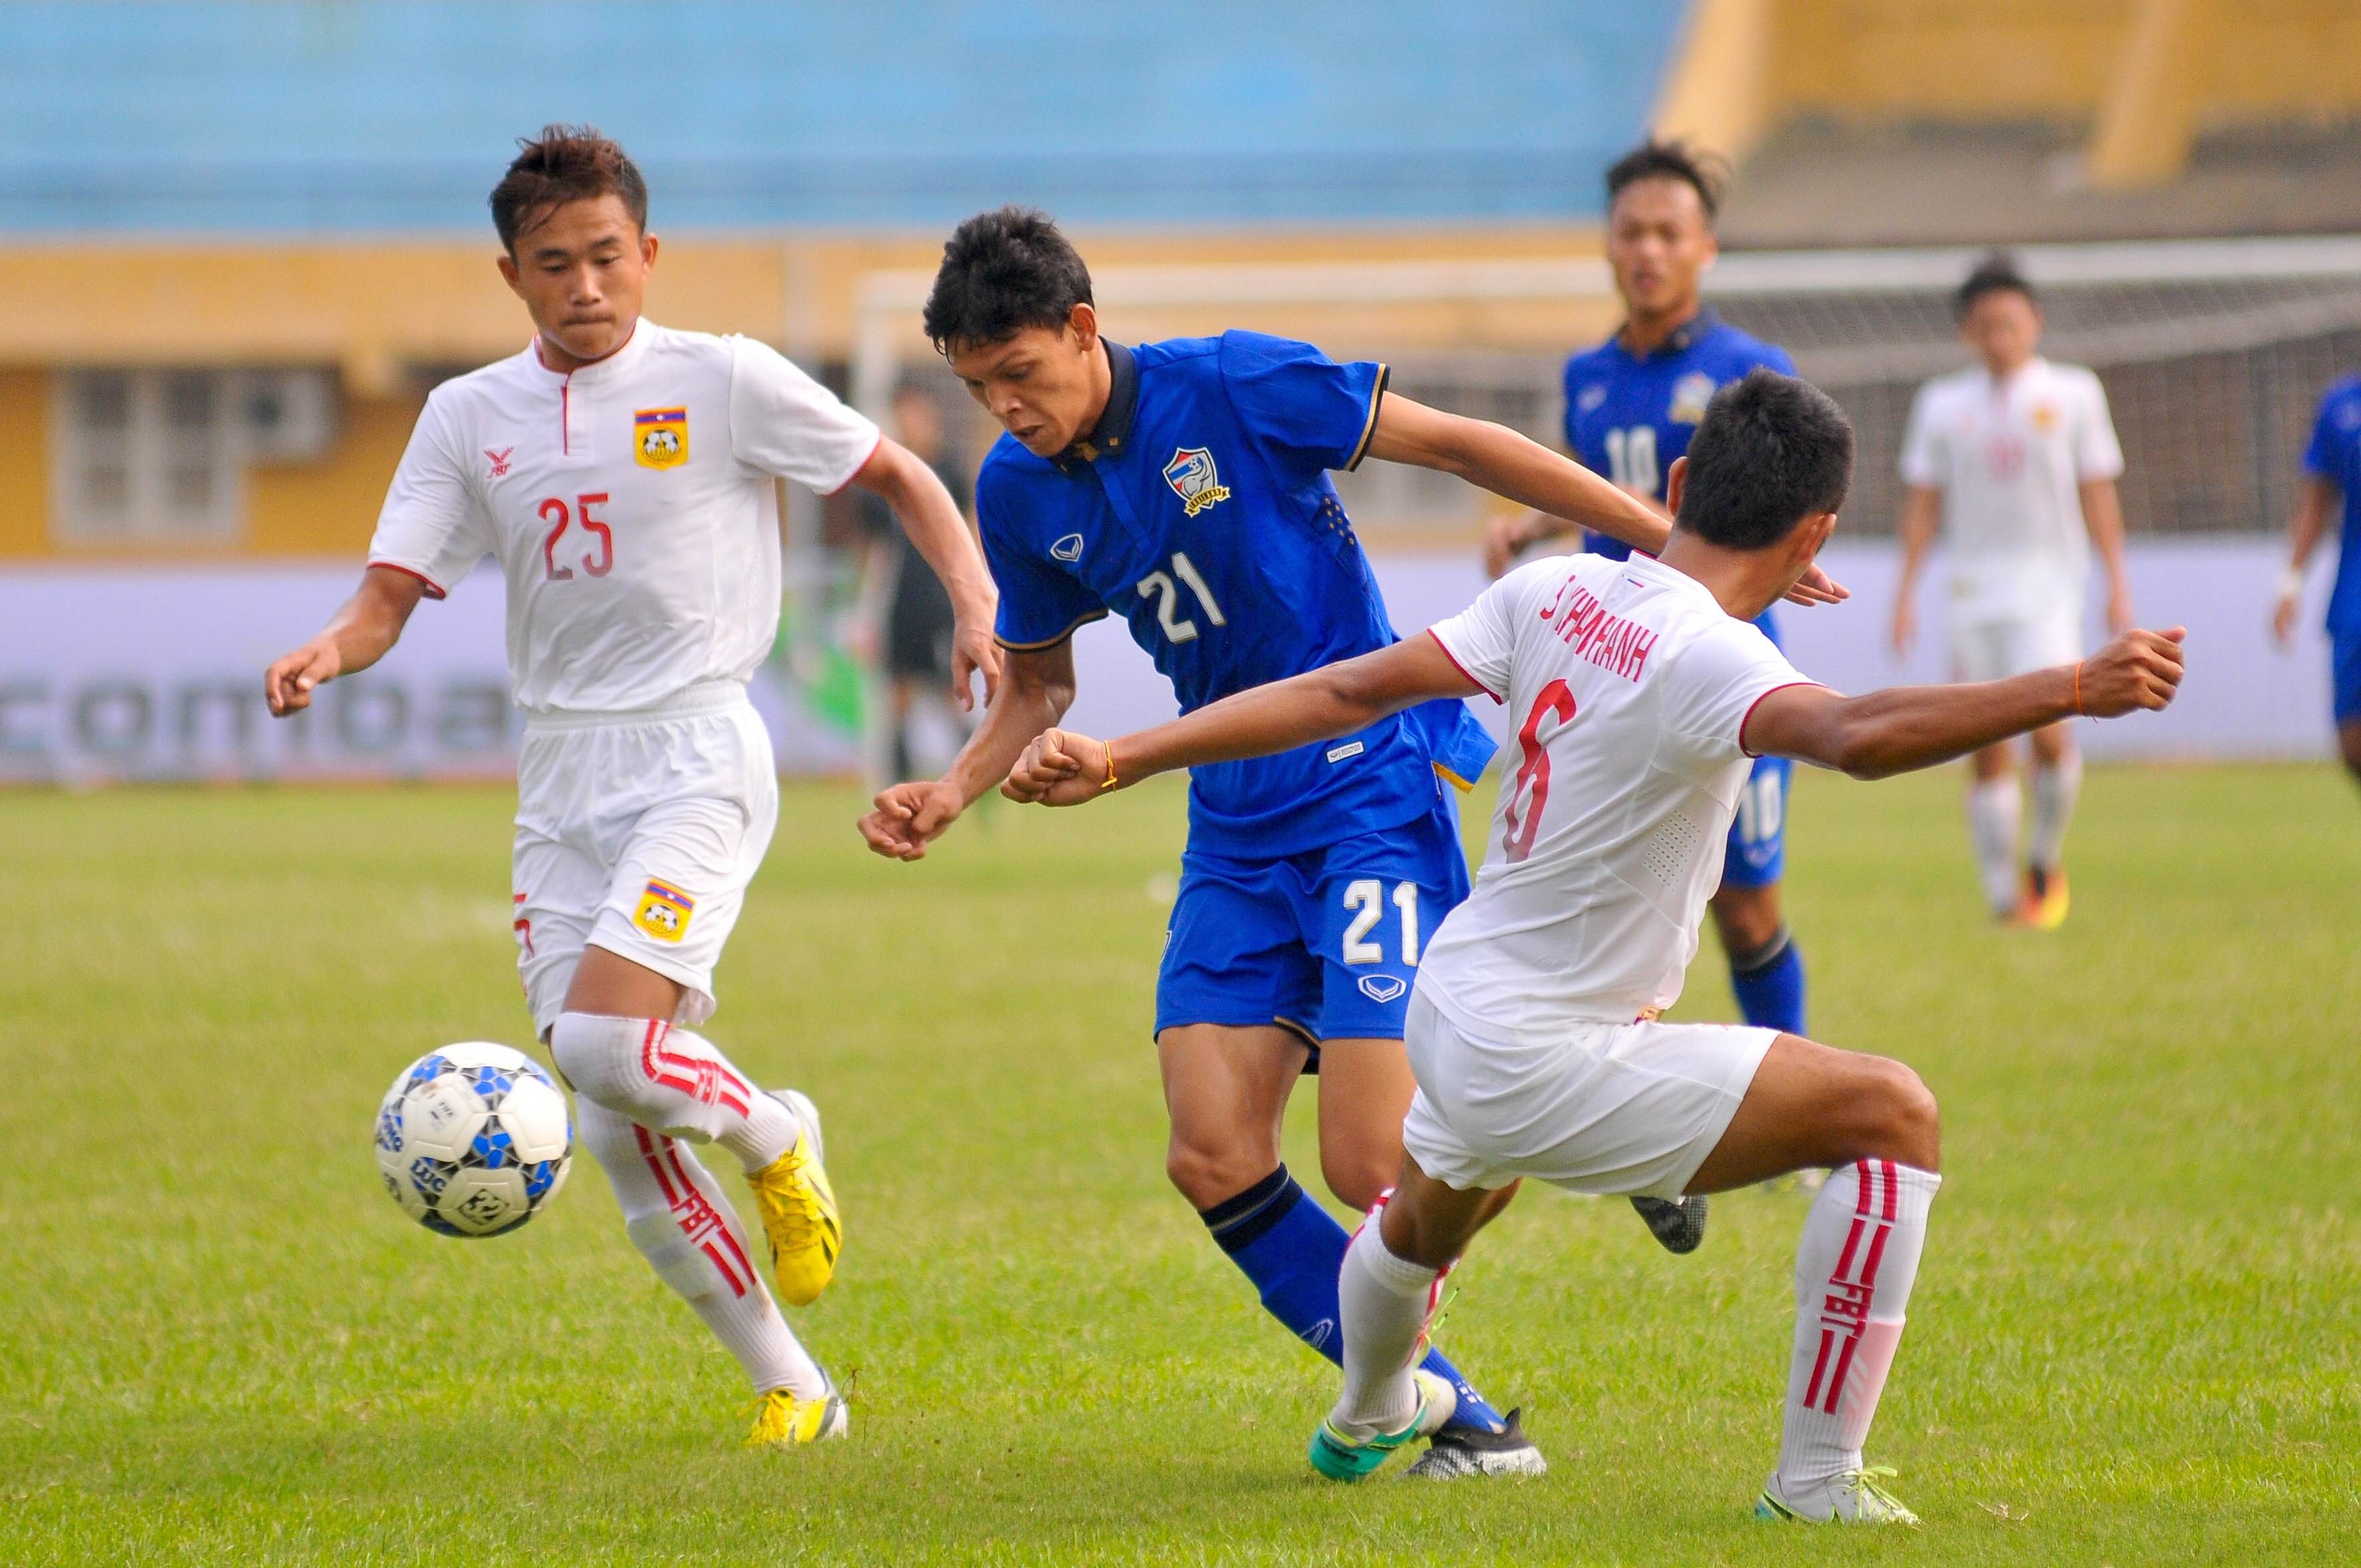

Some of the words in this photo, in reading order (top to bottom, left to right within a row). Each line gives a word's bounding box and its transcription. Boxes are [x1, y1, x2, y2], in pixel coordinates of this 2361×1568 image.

[1606, 426, 1659, 494] 10
[538, 492, 613, 580] 25
[1137, 552, 1224, 642] 21
[1502, 679, 1576, 864] 6
[1740, 769, 1782, 844] 10
[1343, 880, 1419, 967] 21
[670, 1191, 723, 1243] FBT
[1821, 1278, 1874, 1339] FBT
